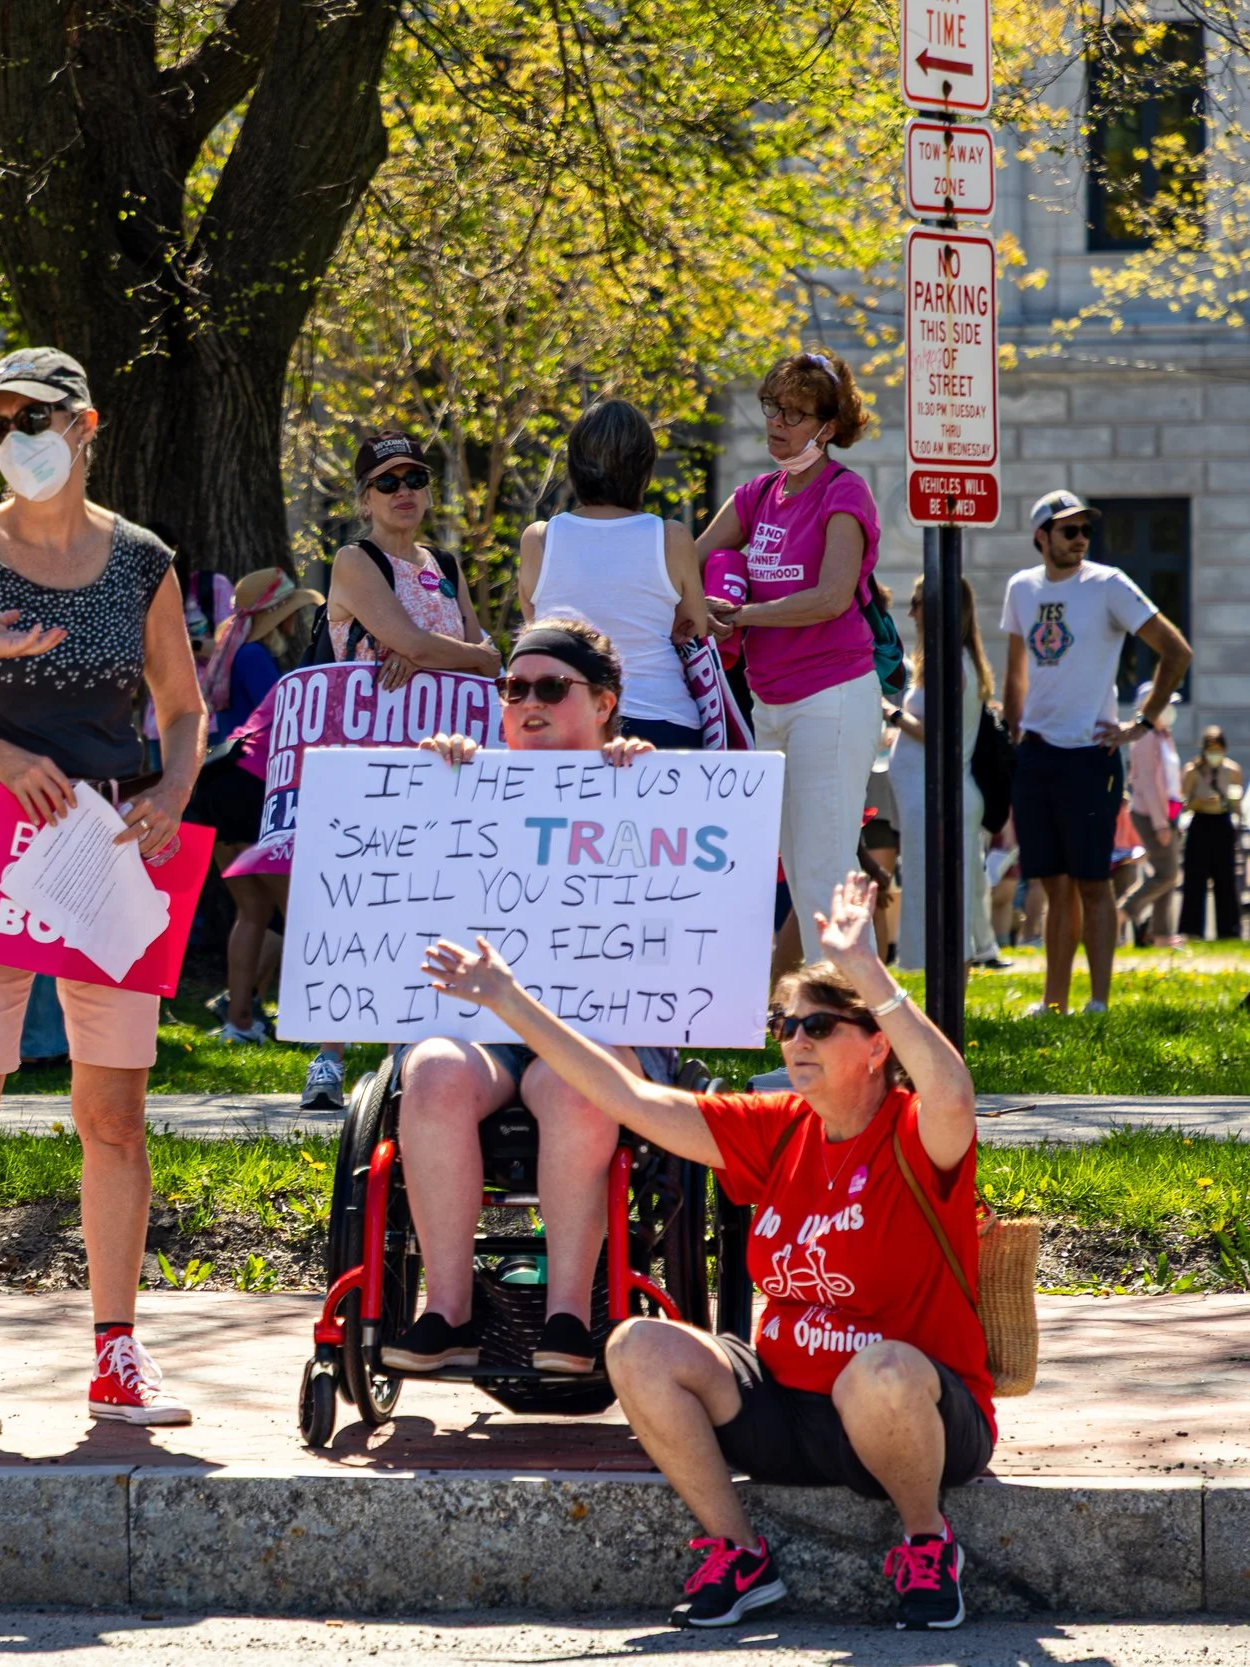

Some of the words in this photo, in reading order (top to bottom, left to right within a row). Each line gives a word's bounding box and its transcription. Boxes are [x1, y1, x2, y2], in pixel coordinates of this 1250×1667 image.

[926, 9, 966, 48] TIME
[919, 142, 984, 164] TOW-AWAY
[934, 177, 966, 197] ZONE
[938, 248, 961, 279] NO
[914, 281, 988, 316] PARKING
[920, 320, 946, 342] THIS
[953, 322, 982, 345] SIDE
[942, 348, 959, 369] OF
[929, 374, 974, 397] STREET
[936, 403, 947, 417] PM
[950, 404, 987, 419] TUESDAY
[941, 424, 961, 438] THRU
[914, 440, 931, 454] 7:00
[933, 442, 944, 454] AM
[947, 442, 991, 457] WEDNESDAY
[919, 477, 961, 495] VEHICLES
[964, 478, 987, 496] WILL
[929, 498, 941, 515] BE
[945, 499, 976, 517] TWED
[1039, 603, 1065, 621] YES
[270, 672, 329, 755] PRO
[365, 763, 433, 799] IF
[454, 761, 534, 801] THE
[555, 763, 681, 802] FETUS
[699, 763, 765, 800] YOU
[445, 820, 499, 859] IS
[525, 817, 736, 875] TRANS,
[320, 871, 455, 907] WILL
[478, 867, 550, 914] YOU
[561, 875, 702, 906] STILL
[303, 929, 441, 968] WANT
[550, 924, 718, 965] FIGHT
[306, 982, 378, 1025] FOR
